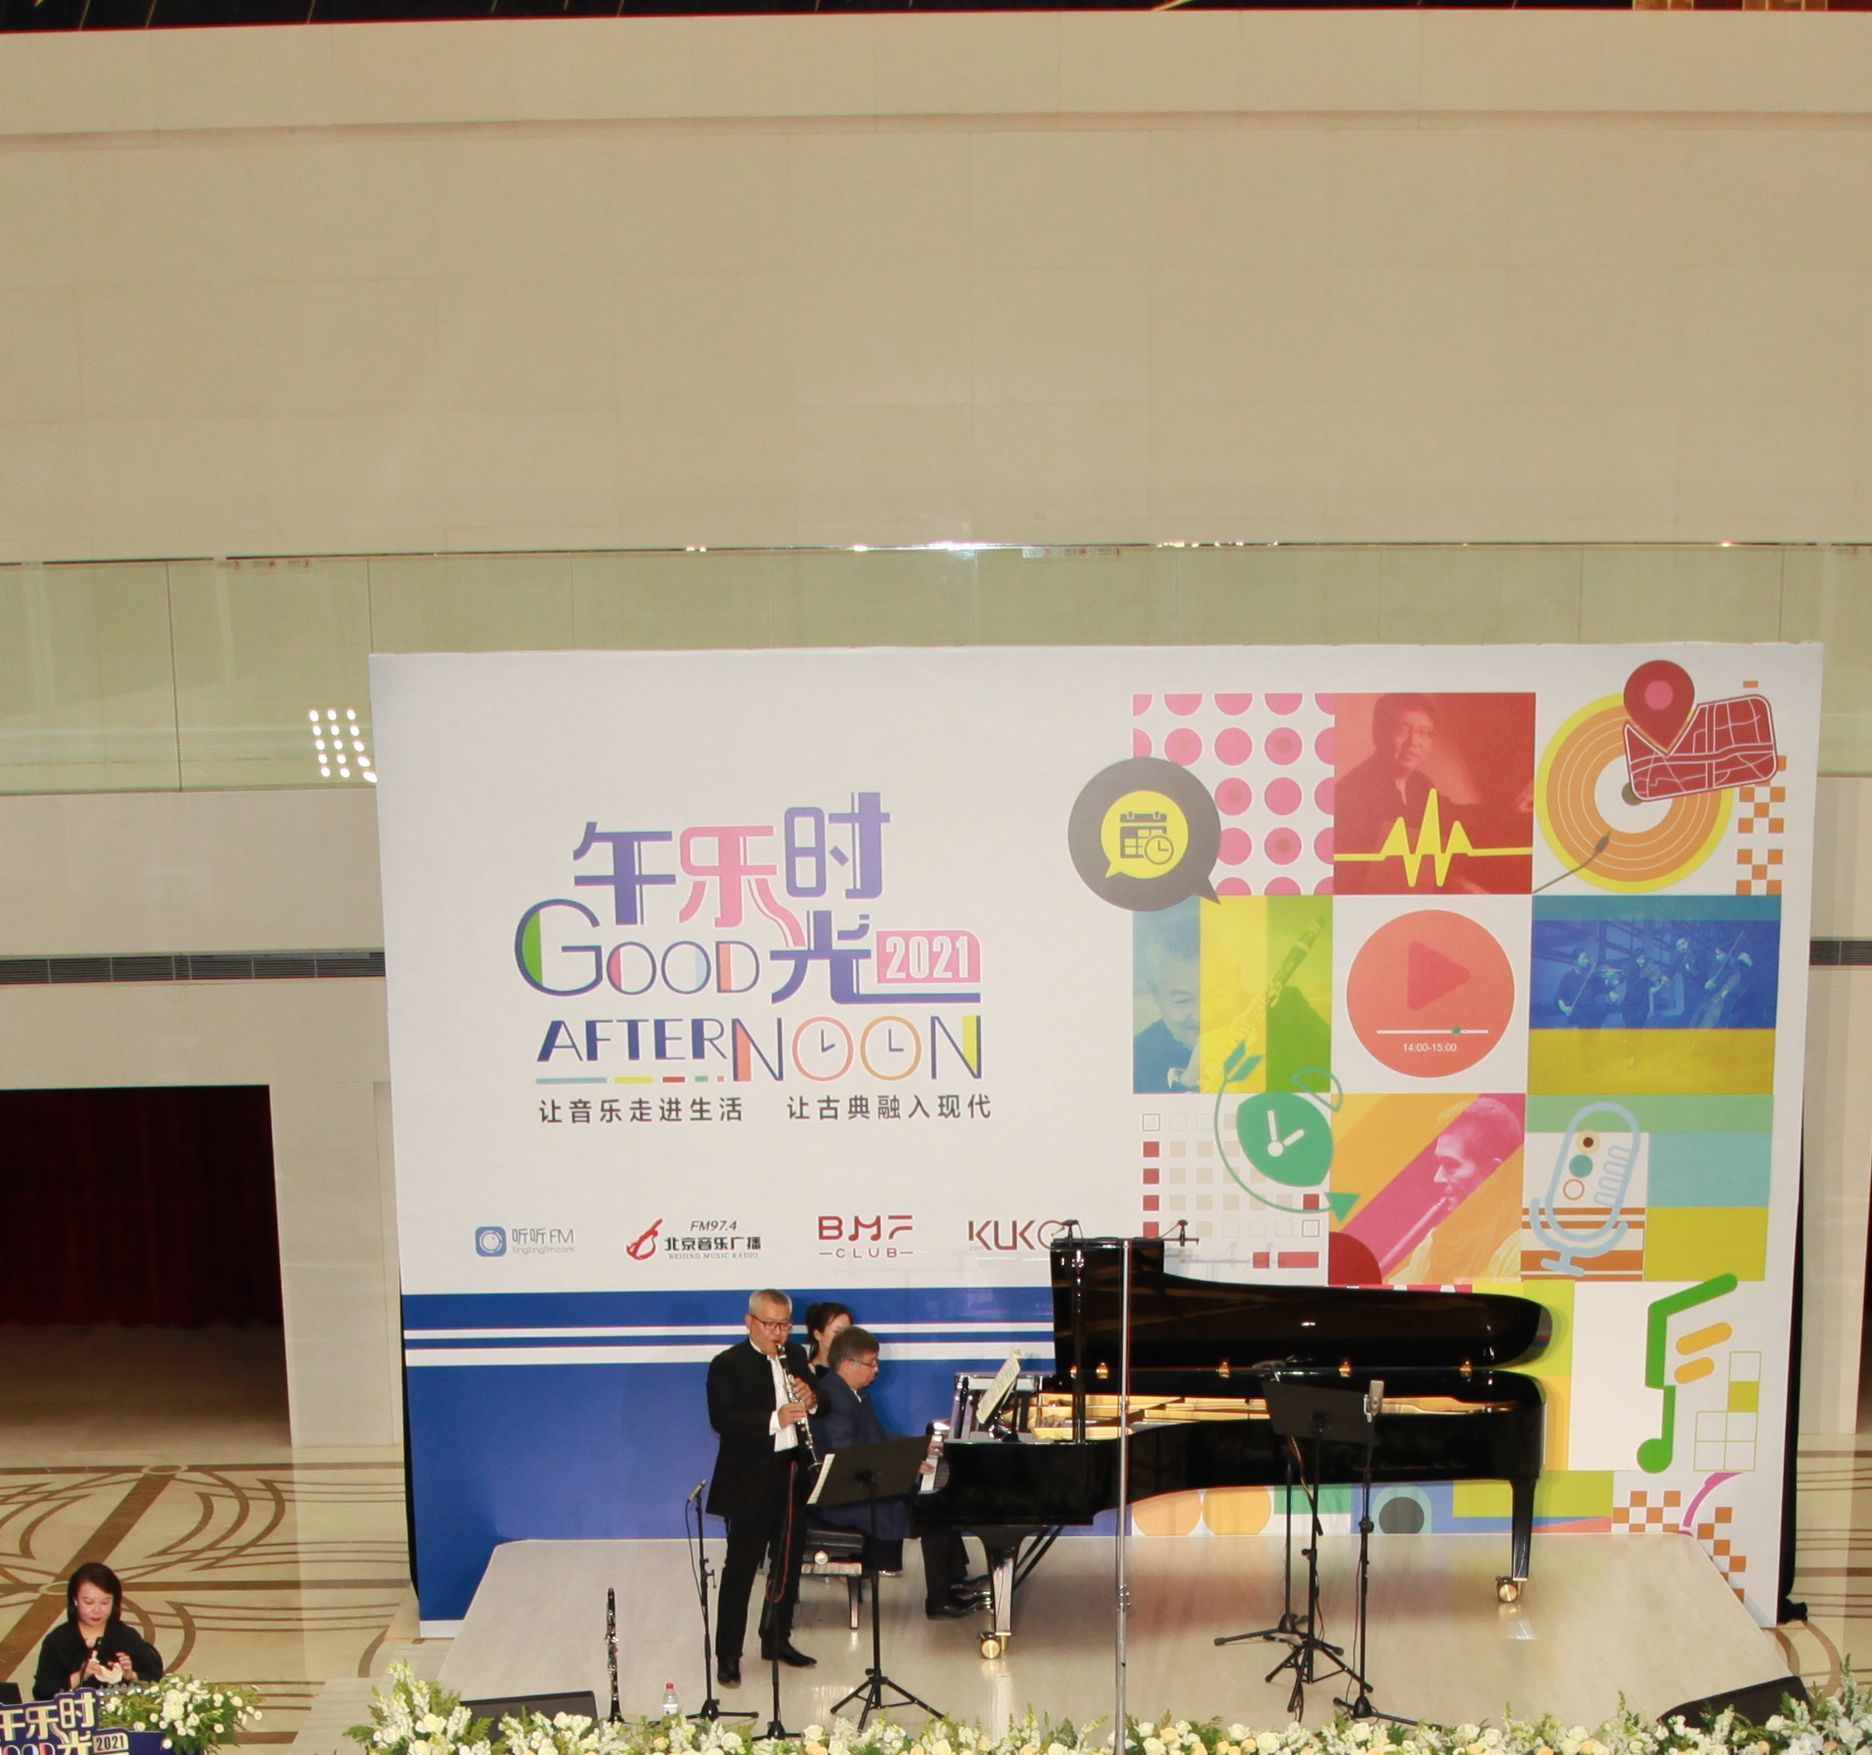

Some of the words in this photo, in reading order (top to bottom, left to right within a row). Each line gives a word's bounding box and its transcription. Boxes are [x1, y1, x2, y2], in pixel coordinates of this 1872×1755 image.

[515, 899, 760, 997] GOOD
[885, 935, 970, 980] 2021
[537, 1015, 982, 1082] AFTERNOON
[539, 1098, 744, 1124] 让音乐走进生活
[787, 1094, 992, 1121] 让古典融入现代
[690, 1220, 737, 1231] FM97.4
[664, 1236, 761, 1251] 北京音乐广播
[835, 1247, 898, 1259] CLUB
[95, 1735, 125, 1751] 2021
